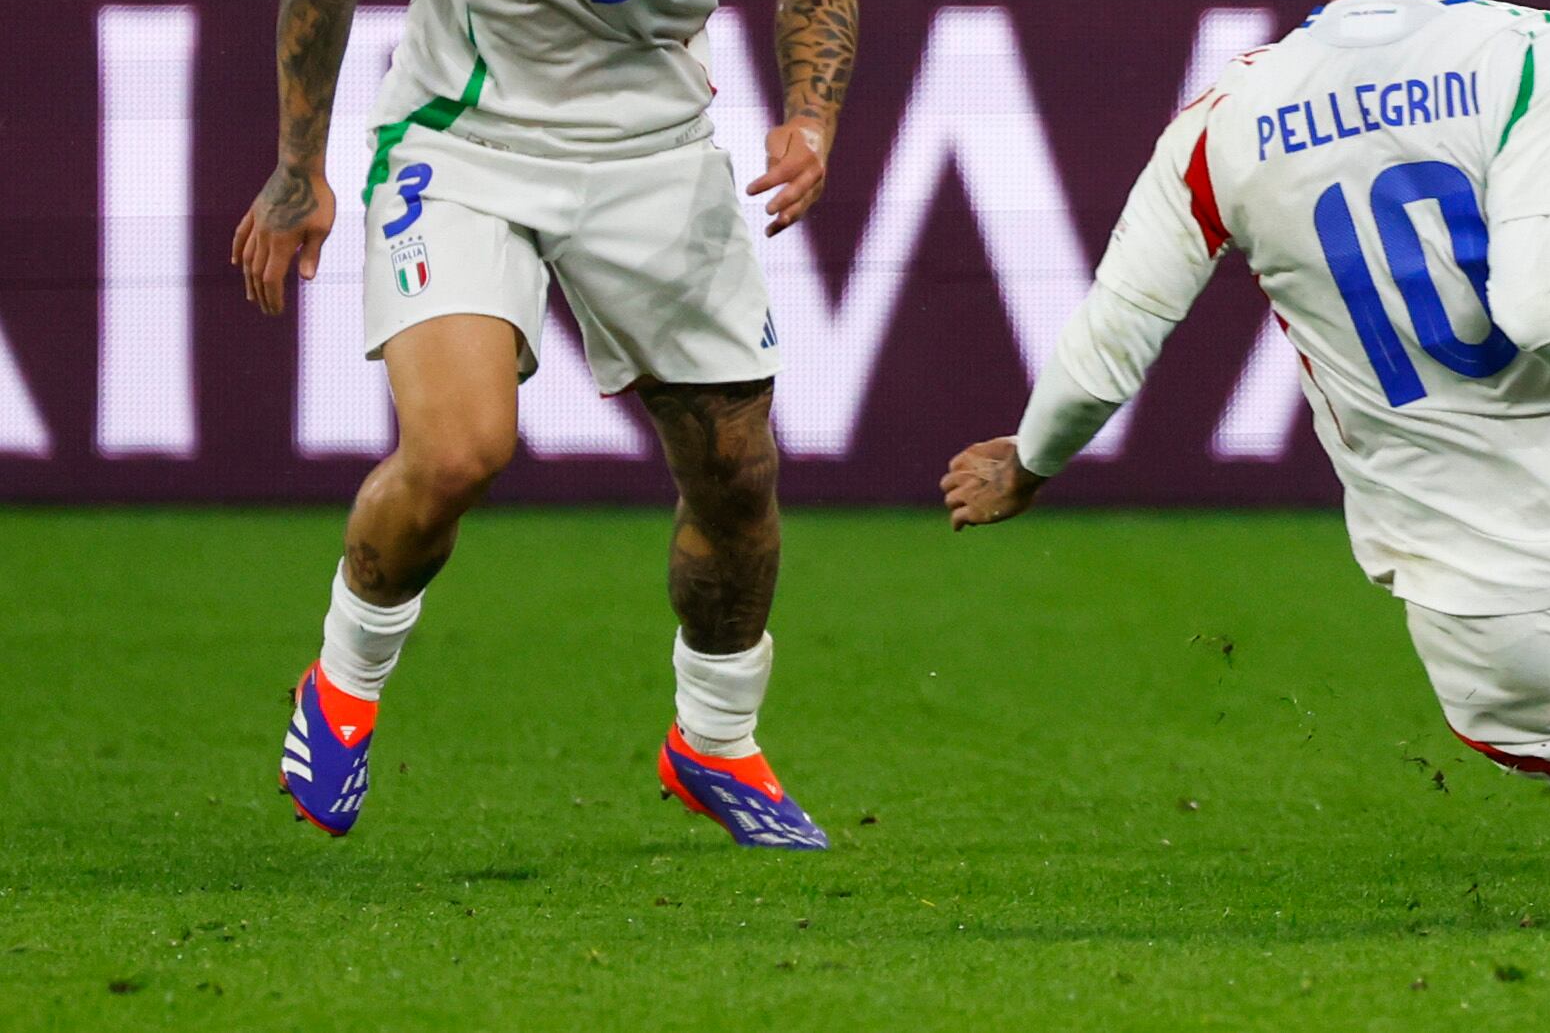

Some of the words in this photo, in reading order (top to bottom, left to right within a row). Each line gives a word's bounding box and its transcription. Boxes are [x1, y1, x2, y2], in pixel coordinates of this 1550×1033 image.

[1256, 71, 1482, 162] PELLEGRINI
[382, 163, 433, 240] 3
[394, 248, 424, 265] ITALIA
[1313, 160, 1519, 408] 10
